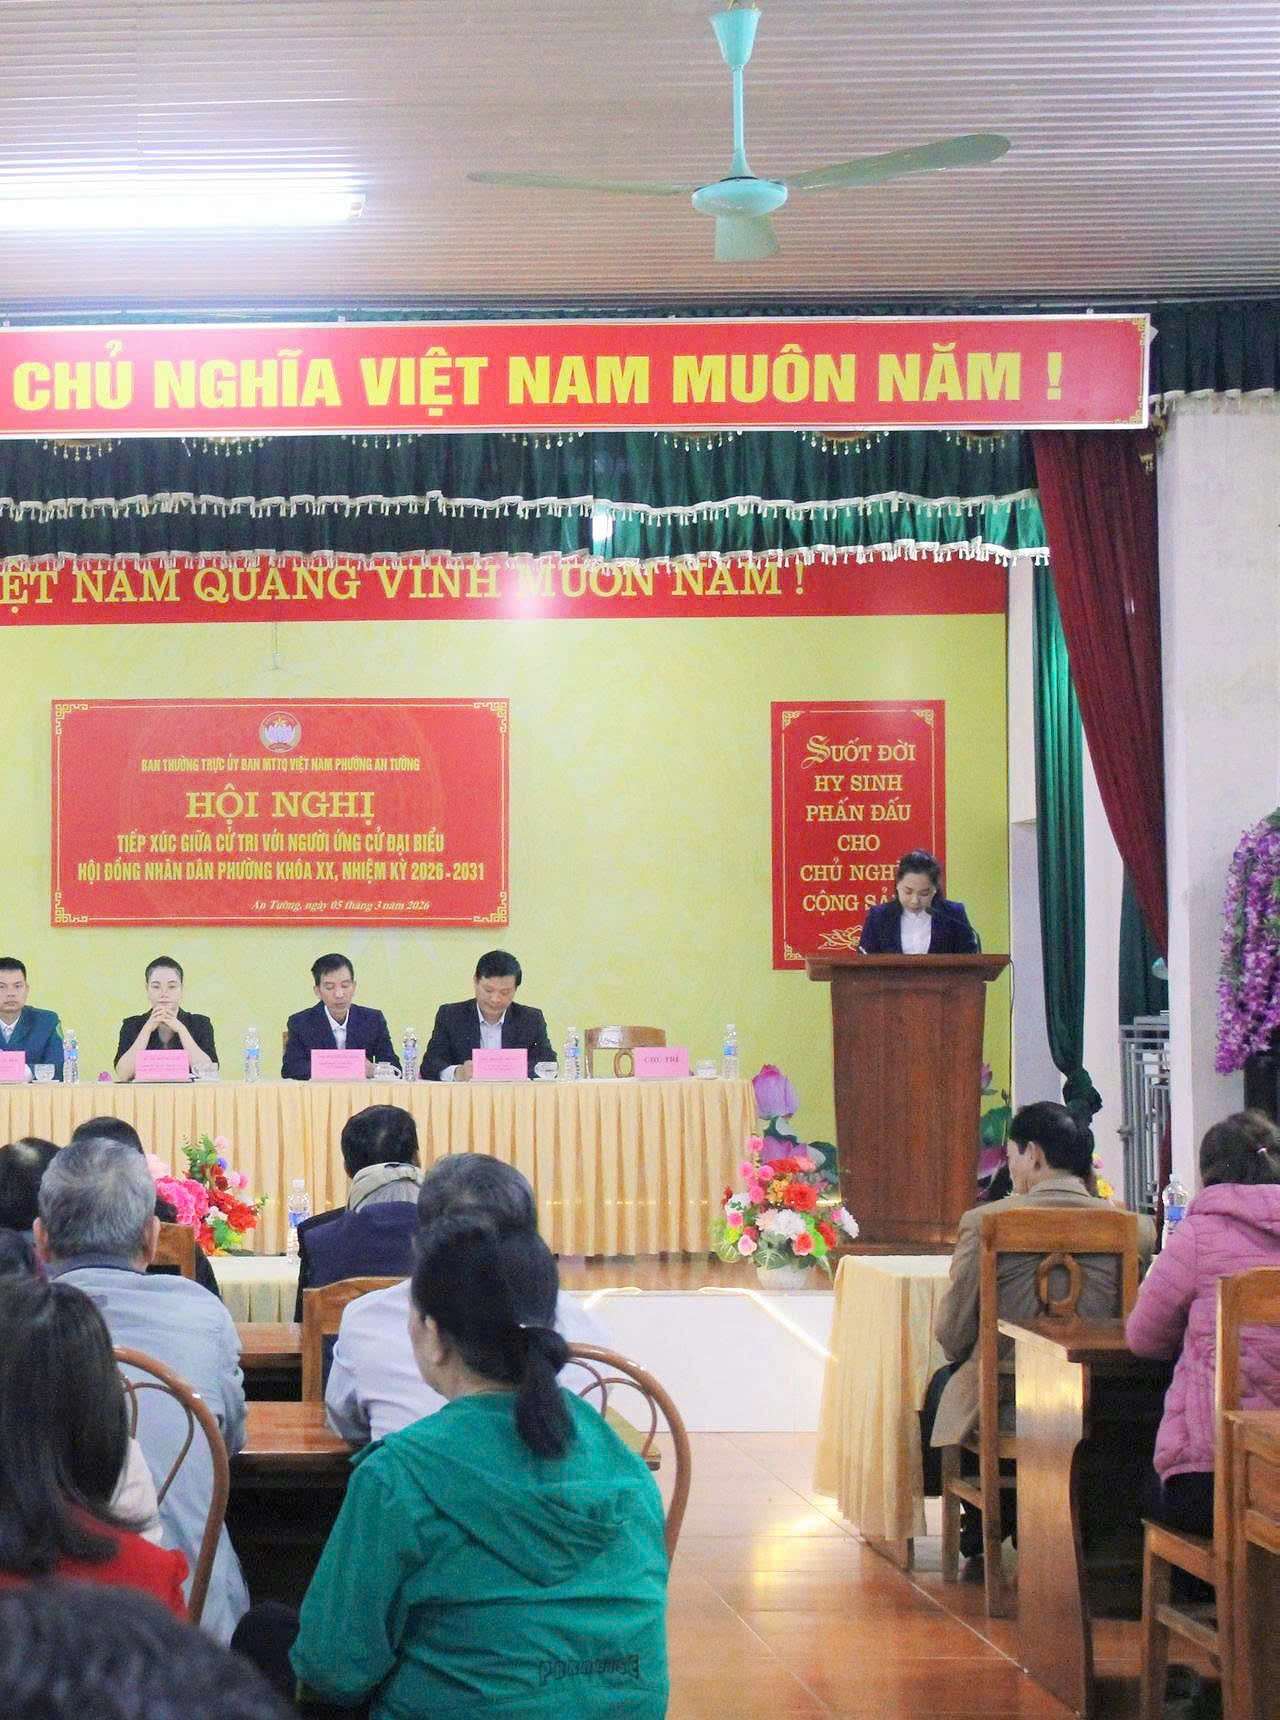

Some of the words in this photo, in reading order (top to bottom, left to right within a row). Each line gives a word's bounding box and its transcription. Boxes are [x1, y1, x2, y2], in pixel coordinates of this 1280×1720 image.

[13, 339, 133, 410] CHỦ
[154, 348, 341, 408] NGHĨA
[360, 346, 488, 416] VIỆT
[508, 355, 649, 404] NAM
[673, 343, 855, 404] MUÔN
[879, 342, 1021, 402] NĂM
[1047, 351, 1062, 400] !
[72, 568, 180, 603] NAM
[194, 566, 361, 603] QUANG
[376, 563, 500, 598] VINH
[796, 560, 804, 595] !
[878, 739, 916, 761] ĐỜI
[140, 758, 161, 772] BAN
[241, 758, 260, 771] BAN
[262, 758, 287, 772] MTTQ
[289, 756, 309, 774] VIỆT
[311, 758, 333, 771] NAM
[374, 758, 387, 771] AN
[814, 775, 844, 792] HY
[850, 775, 903, 792] SINH
[185, 783, 259, 825] HỘI
[271, 791, 375, 826] NGHỊ
[806, 797, 864, 822] PHẤN
[871, 796, 911, 821] ĐẤU
[117, 828, 146, 853] TIẾP
[150, 830, 177, 852] XÚC
[181, 829, 212, 852] GIỮA
[216, 826, 235, 852] CỬ
[238, 833, 259, 852] TRI
[262, 828, 284, 852] VỚI
[288, 829, 329, 852] NGƯỜI
[333, 829, 361, 852] ỨNG
[365, 826, 385, 852] CỬ
[387, 833, 410, 856] ĐẠI
[414, 826, 445, 852] BIỂU
[837, 834, 880, 852] CHO
[78, 858, 101, 885] HỘI
[104, 857, 141, 880] ĐỒNG
[145, 858, 183, 880] NHÂN
[186, 858, 214, 880] DÂN
[218, 857, 272, 880] PHƯỜNG
[276, 858, 313, 881] KHÓA
[316, 861, 339, 882] XX,
[342, 858, 386, 885] NHIỆM
[390, 858, 407, 880] KỲ
[800, 856, 842, 881] CHỦ
[850, 860, 900, 881] NGH
[802, 889, 859, 916] CỘNG
